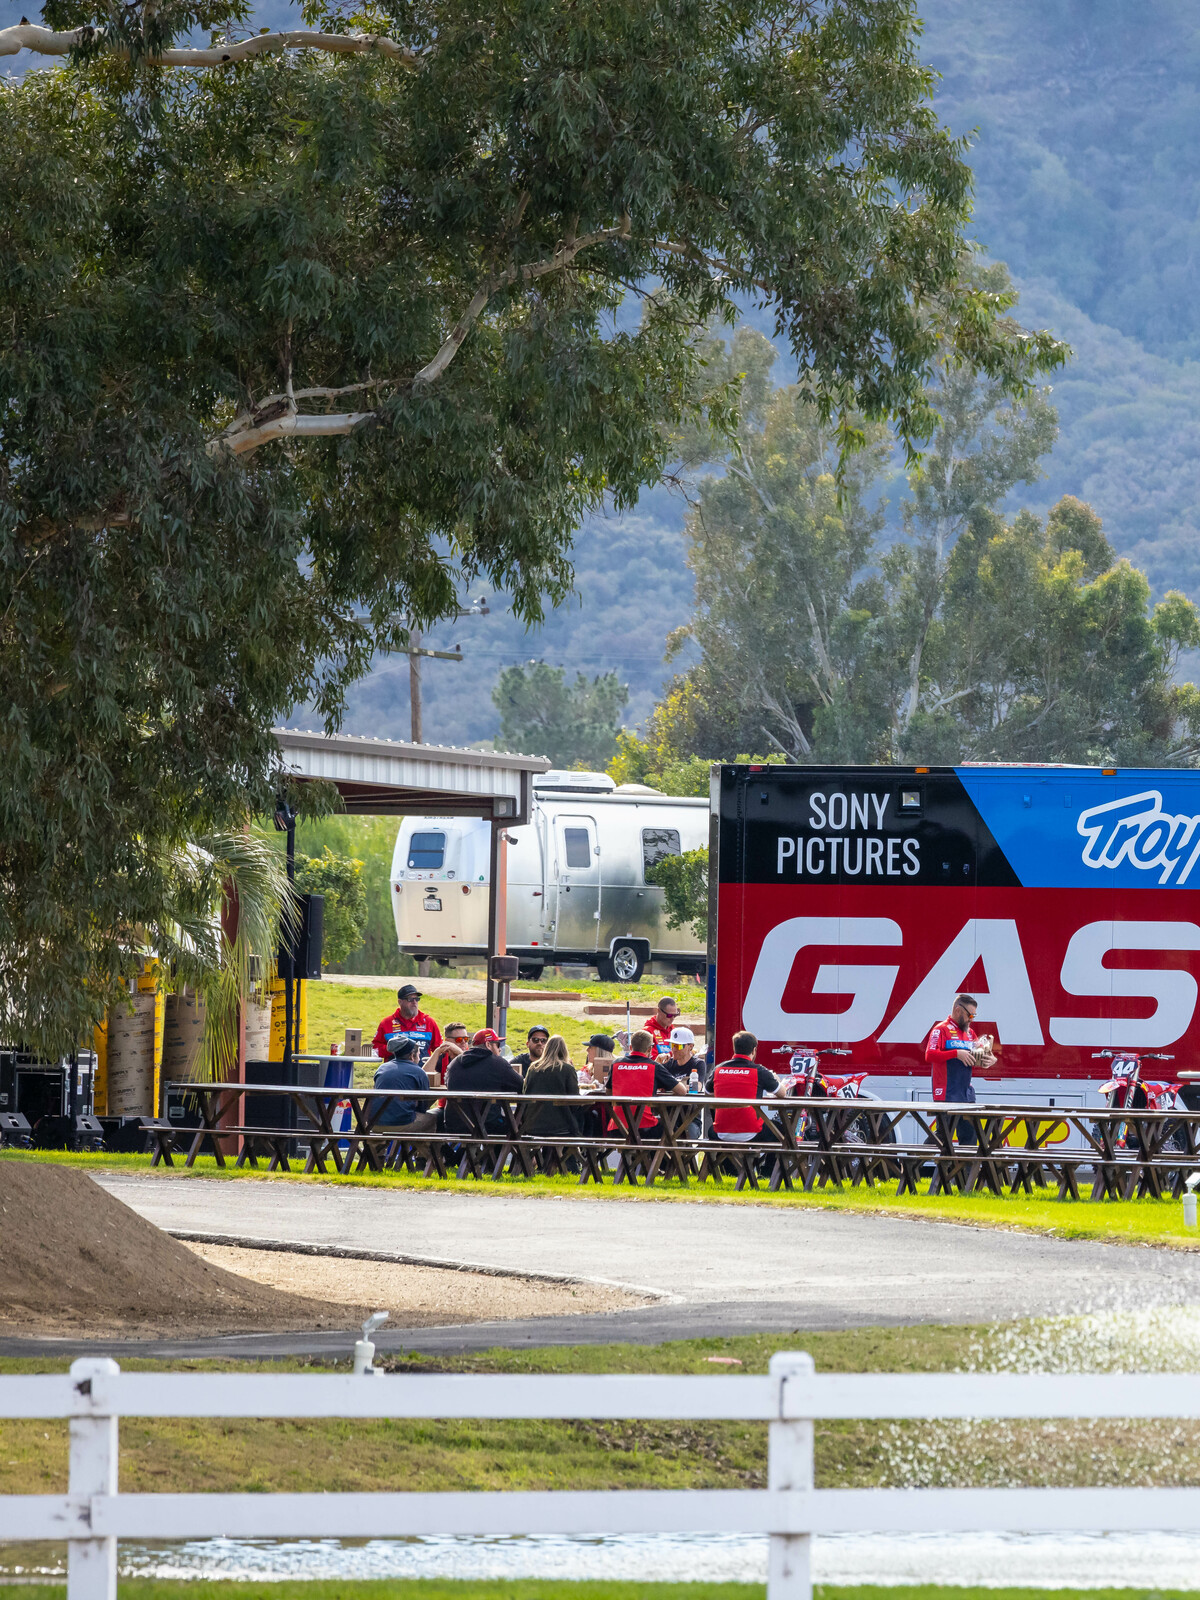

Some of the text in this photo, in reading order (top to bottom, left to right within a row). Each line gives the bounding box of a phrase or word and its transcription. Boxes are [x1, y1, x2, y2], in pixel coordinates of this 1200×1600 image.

[808, 792, 891, 831] SONY
[776, 837, 921, 876] PICTURES
[792, 1057, 812, 1074] 51
[1113, 1061, 1136, 1077] 44
